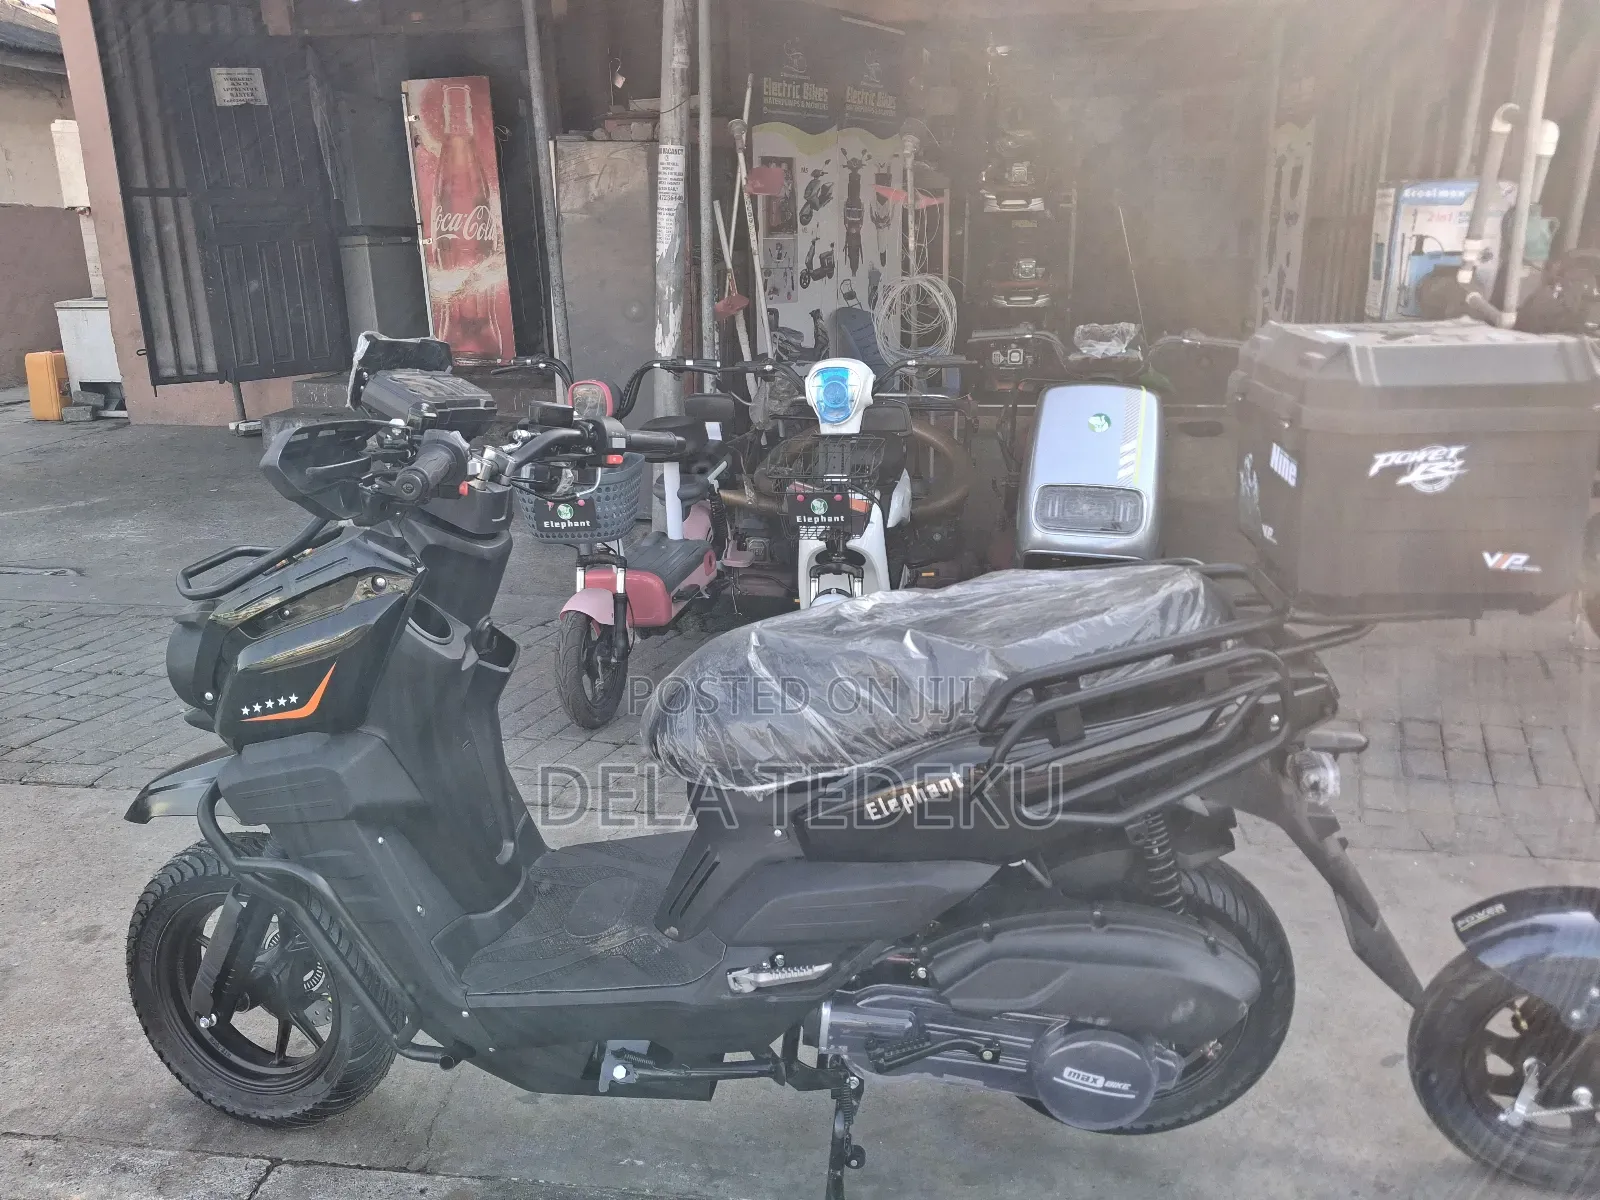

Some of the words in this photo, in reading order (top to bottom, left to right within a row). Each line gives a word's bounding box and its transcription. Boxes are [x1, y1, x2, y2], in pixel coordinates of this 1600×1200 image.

[763, 77, 801, 99] Electric
[803, 82, 829, 102] Bikes
[433, 204, 497, 241] Coca-Cola
[543, 519, 591, 530] Elephant
[795, 514, 845, 525] Elephant
[865, 771, 964, 821] Elephant
